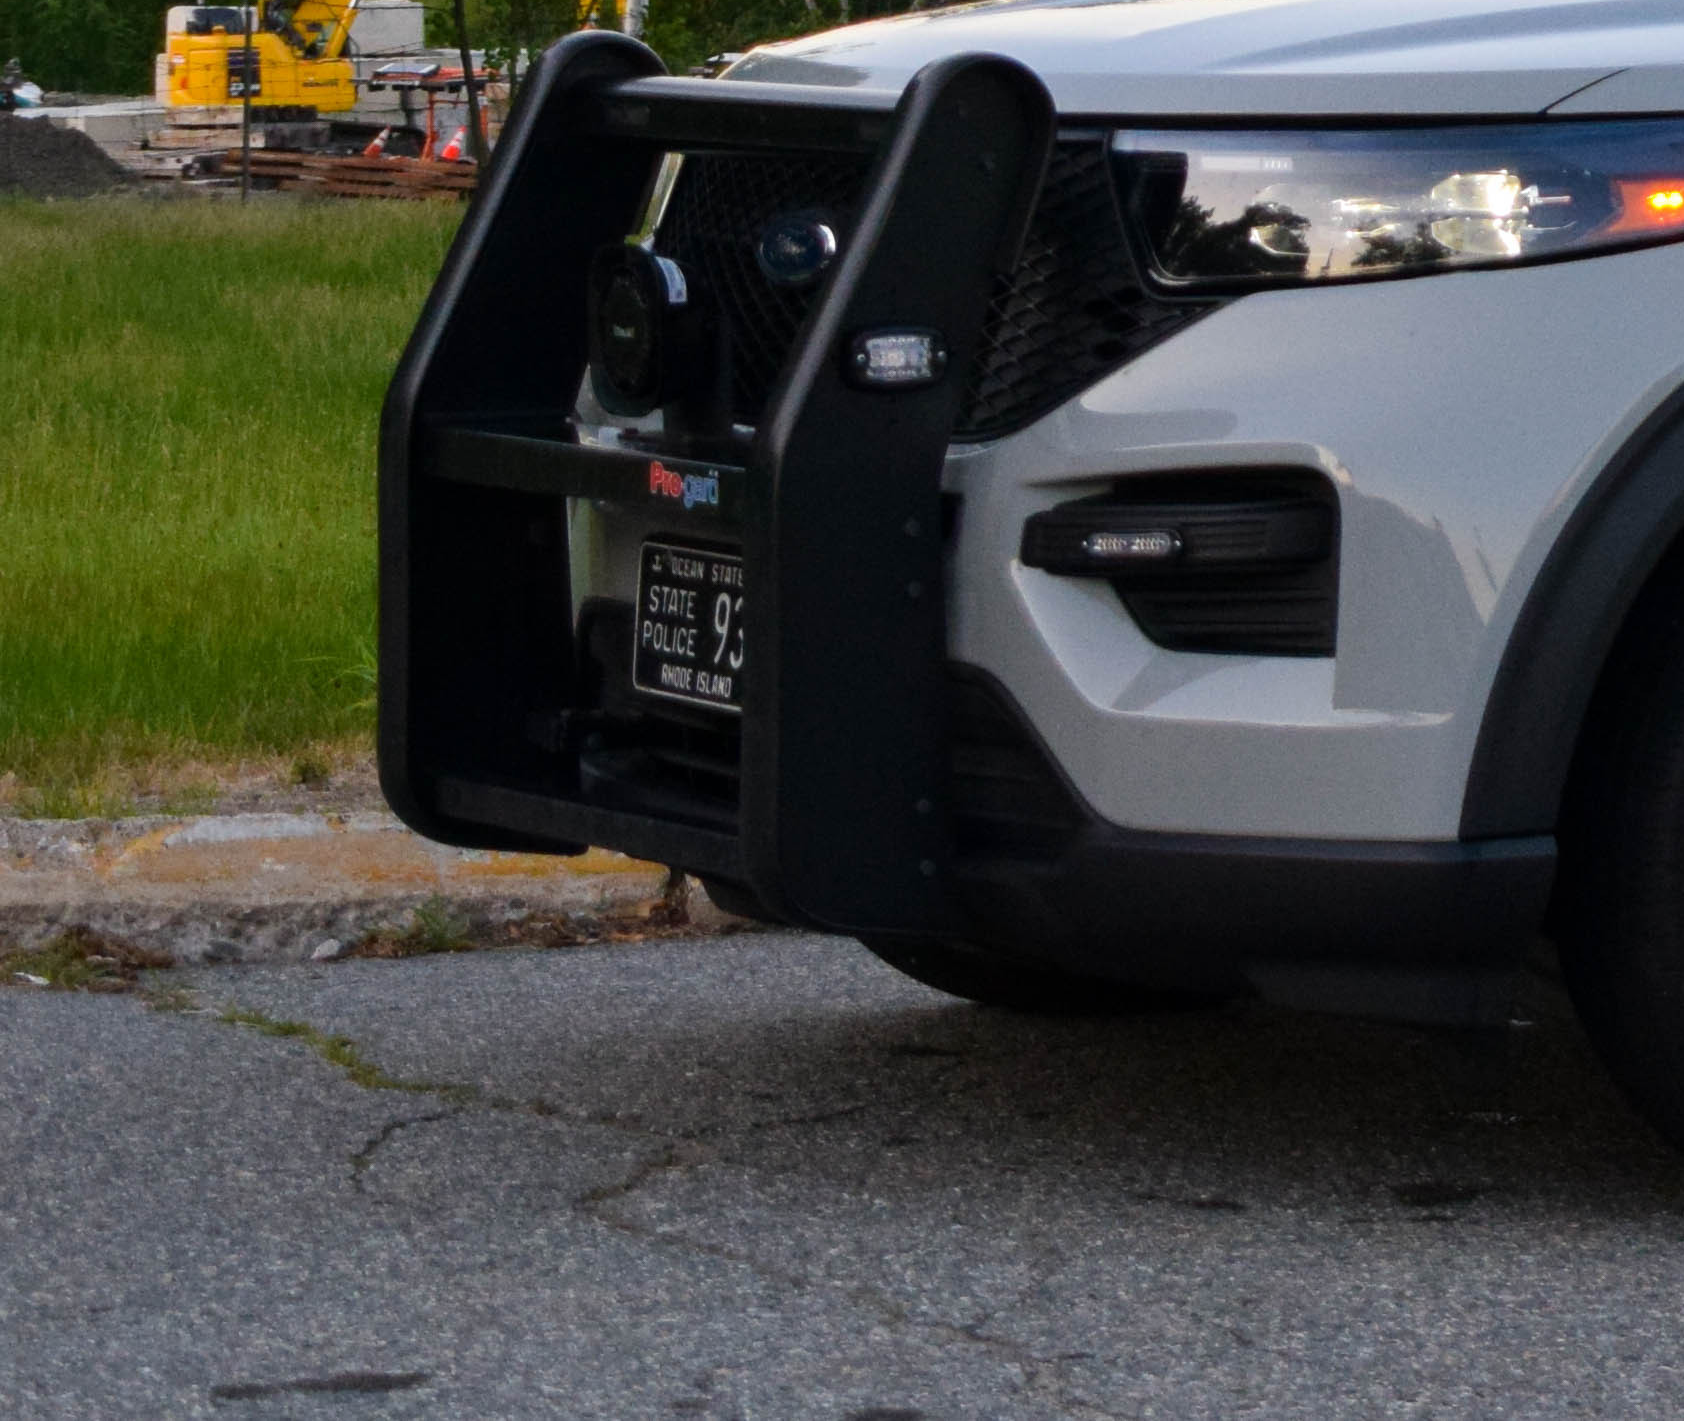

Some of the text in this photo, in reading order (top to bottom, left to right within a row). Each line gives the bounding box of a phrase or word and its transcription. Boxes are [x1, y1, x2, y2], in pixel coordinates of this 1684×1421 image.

[671, 556, 704, 578] OCEAN
[649, 585, 696, 619] STATE
[642, 619, 697, 656] POLICE
[661, 663, 732, 697] RHODE ISLAND
